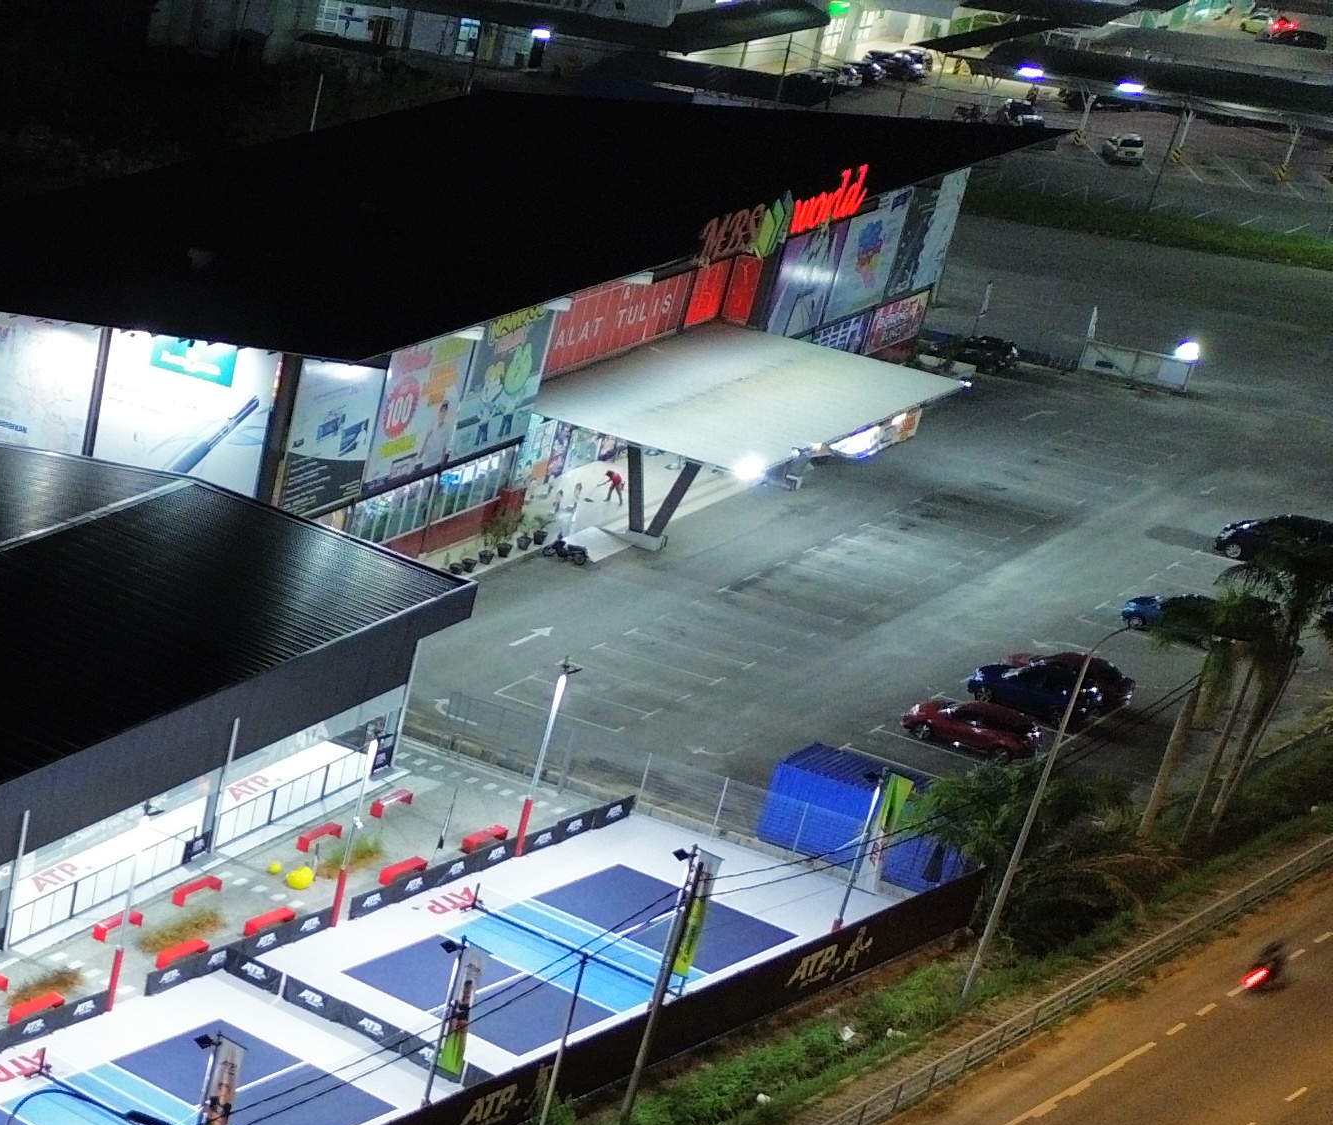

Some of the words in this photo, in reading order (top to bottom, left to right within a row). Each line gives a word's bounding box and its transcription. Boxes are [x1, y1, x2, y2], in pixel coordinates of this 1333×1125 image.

[791, 164, 869, 233] world
[555, 316, 603, 349] ALAT
[617, 294, 673, 328] TULIS
[386, 394, 414, 431] 100
[227, 775, 270, 802] ATP
[31, 862, 79, 893] ATP
[785, 944, 838, 988] ATP
